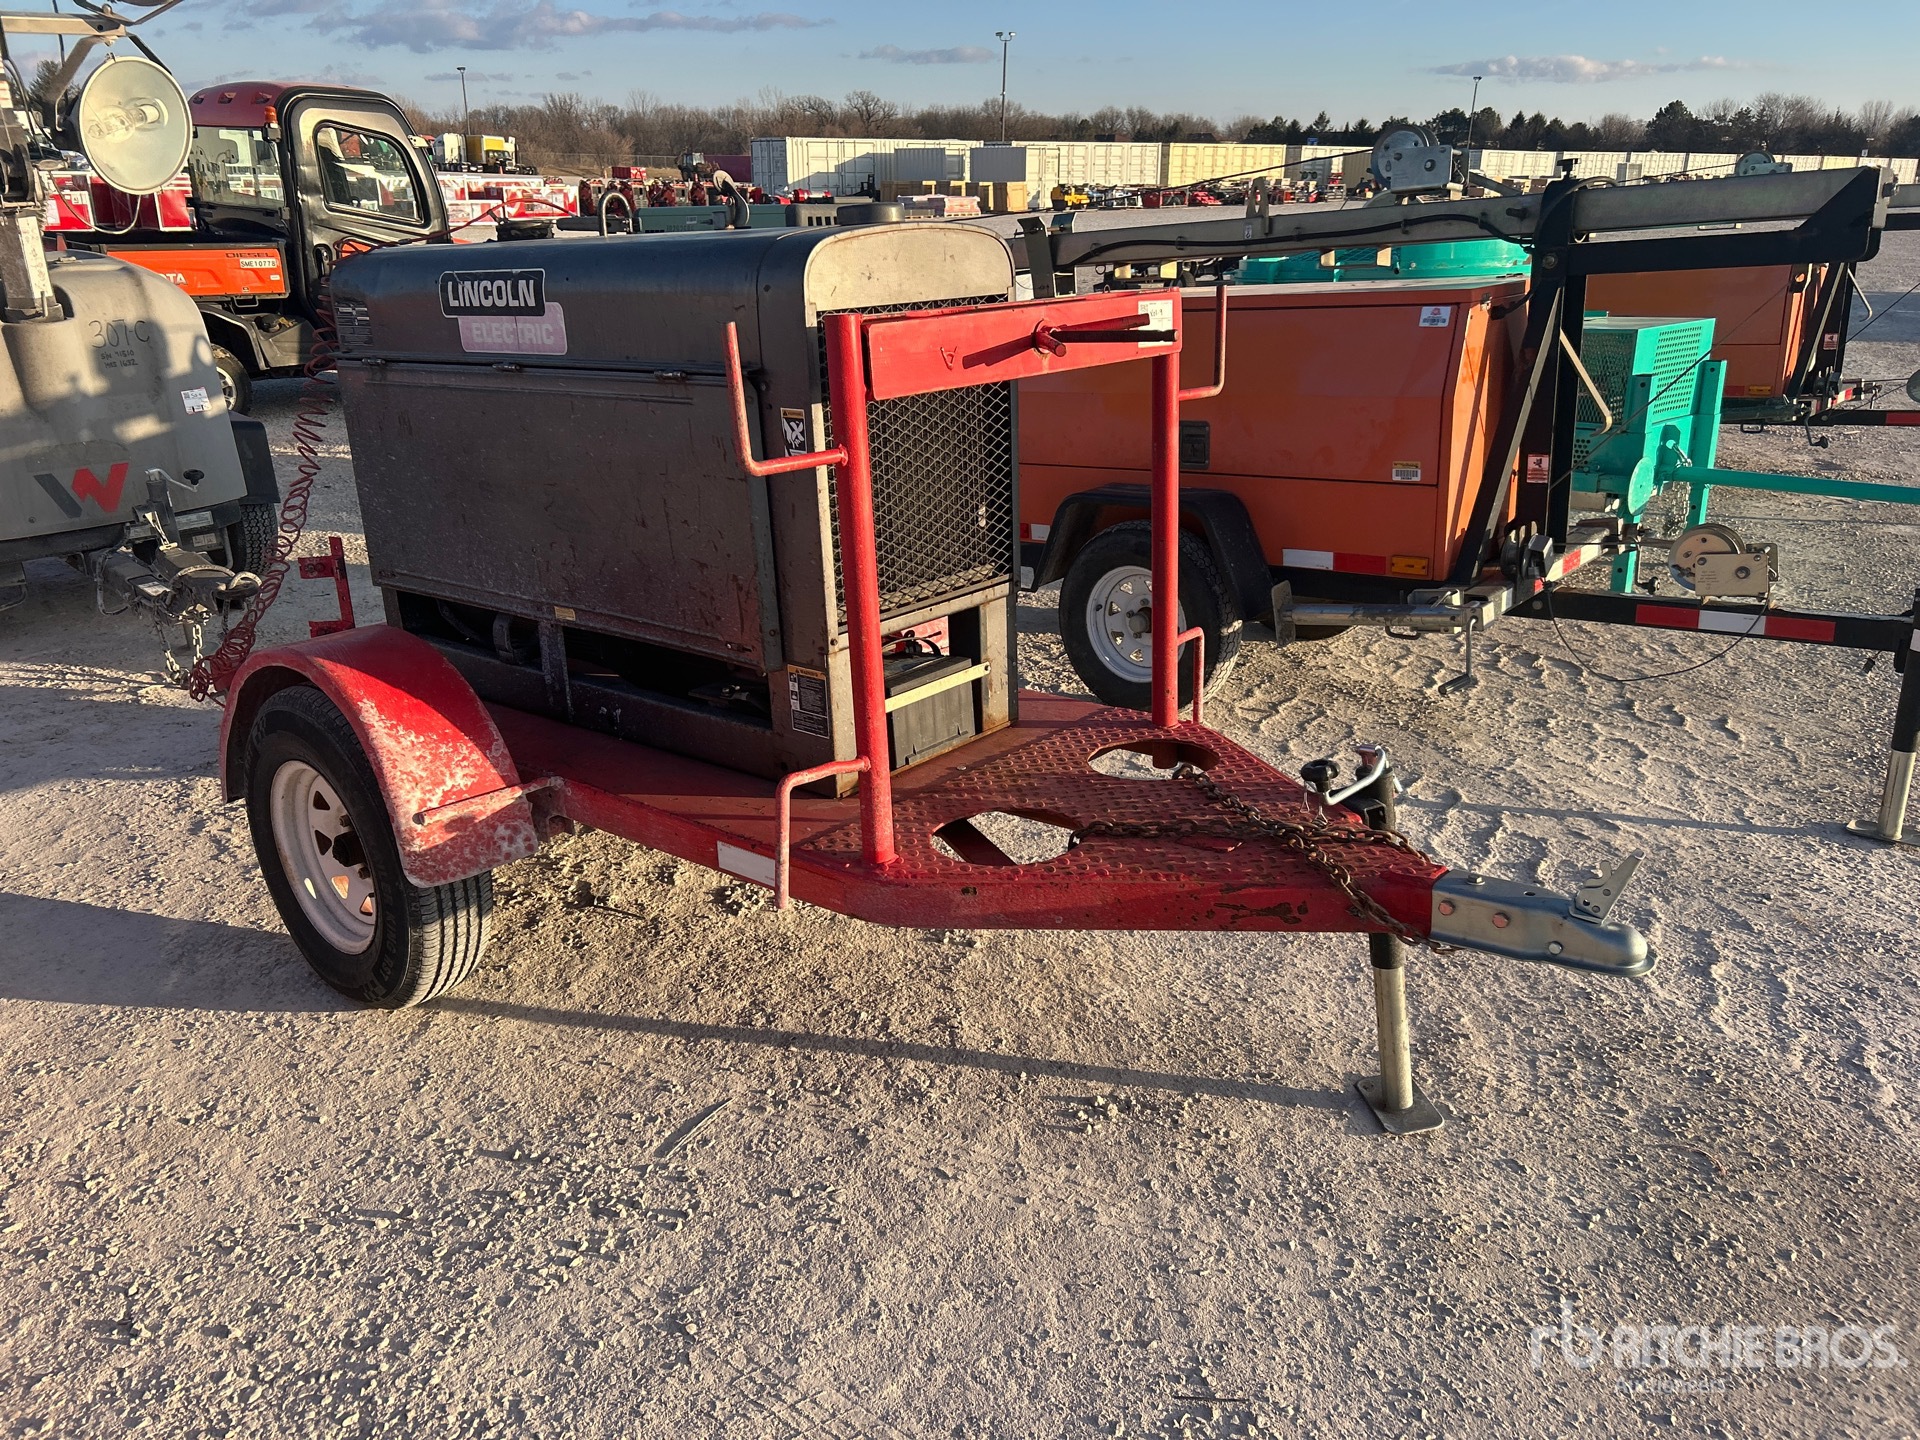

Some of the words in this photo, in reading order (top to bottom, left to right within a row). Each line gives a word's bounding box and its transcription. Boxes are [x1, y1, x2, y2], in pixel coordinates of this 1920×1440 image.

[240, 260, 276, 268] SME10778
[447, 279, 536, 307] LINCOLN
[88, 318, 150, 348] 307-C
[471, 322, 555, 345] ELECTRIC
[385, 911, 397, 954] KING
